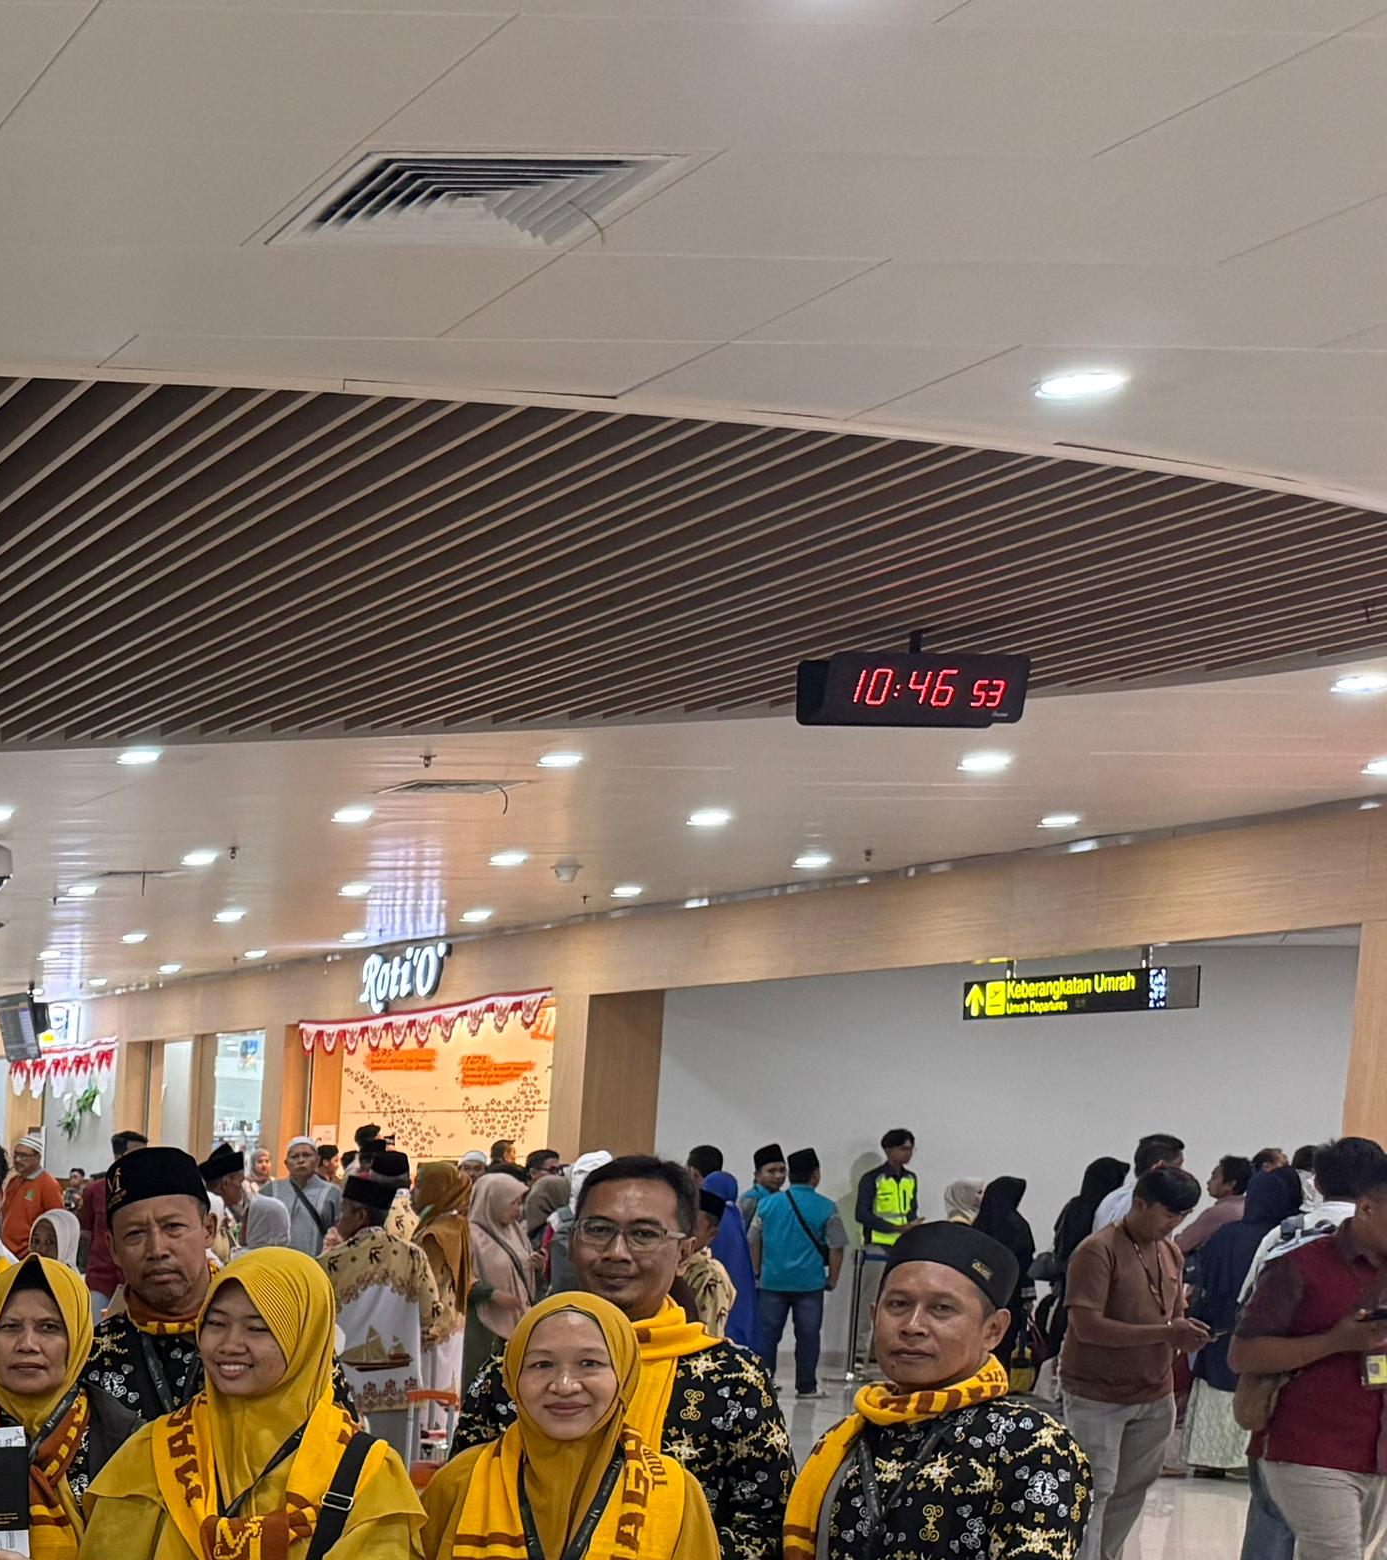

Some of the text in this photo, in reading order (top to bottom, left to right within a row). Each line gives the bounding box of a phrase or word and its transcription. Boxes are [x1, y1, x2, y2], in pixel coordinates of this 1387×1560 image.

[852, 667, 1009, 708] 10:46 53
[1006, 975, 1093, 1001] Keberangkatan
[1093, 971, 1136, 994] Umrah
[1029, 1000, 1069, 1014] Departures
